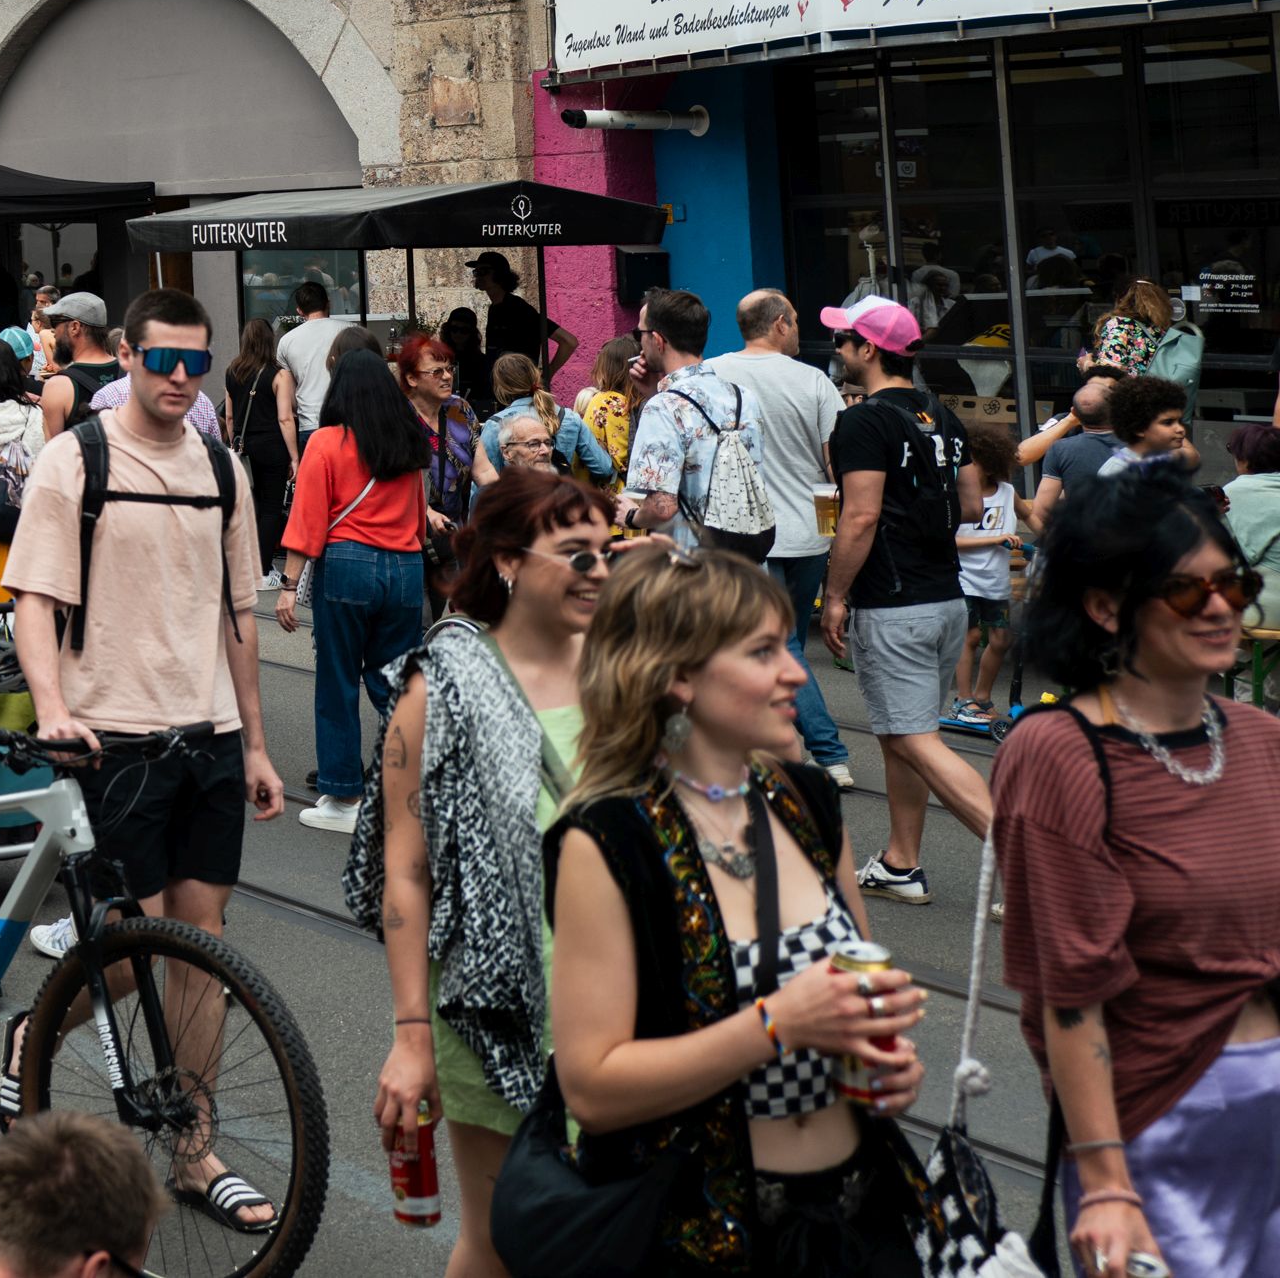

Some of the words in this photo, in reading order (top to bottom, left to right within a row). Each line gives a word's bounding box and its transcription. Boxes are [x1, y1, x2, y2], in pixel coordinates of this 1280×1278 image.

[564, 29, 610, 58] Fugenlose
[614, 21, 646, 47] Wand
[648, 23, 670, 41] und
[673, 2, 790, 36] Bodenbeschichtungen
[192, 221, 287, 248] FUTTERKUTTER
[482, 224, 561, 238] FUTTERKUTTER
[98, 1023, 125, 1090] ROCKSHOX
